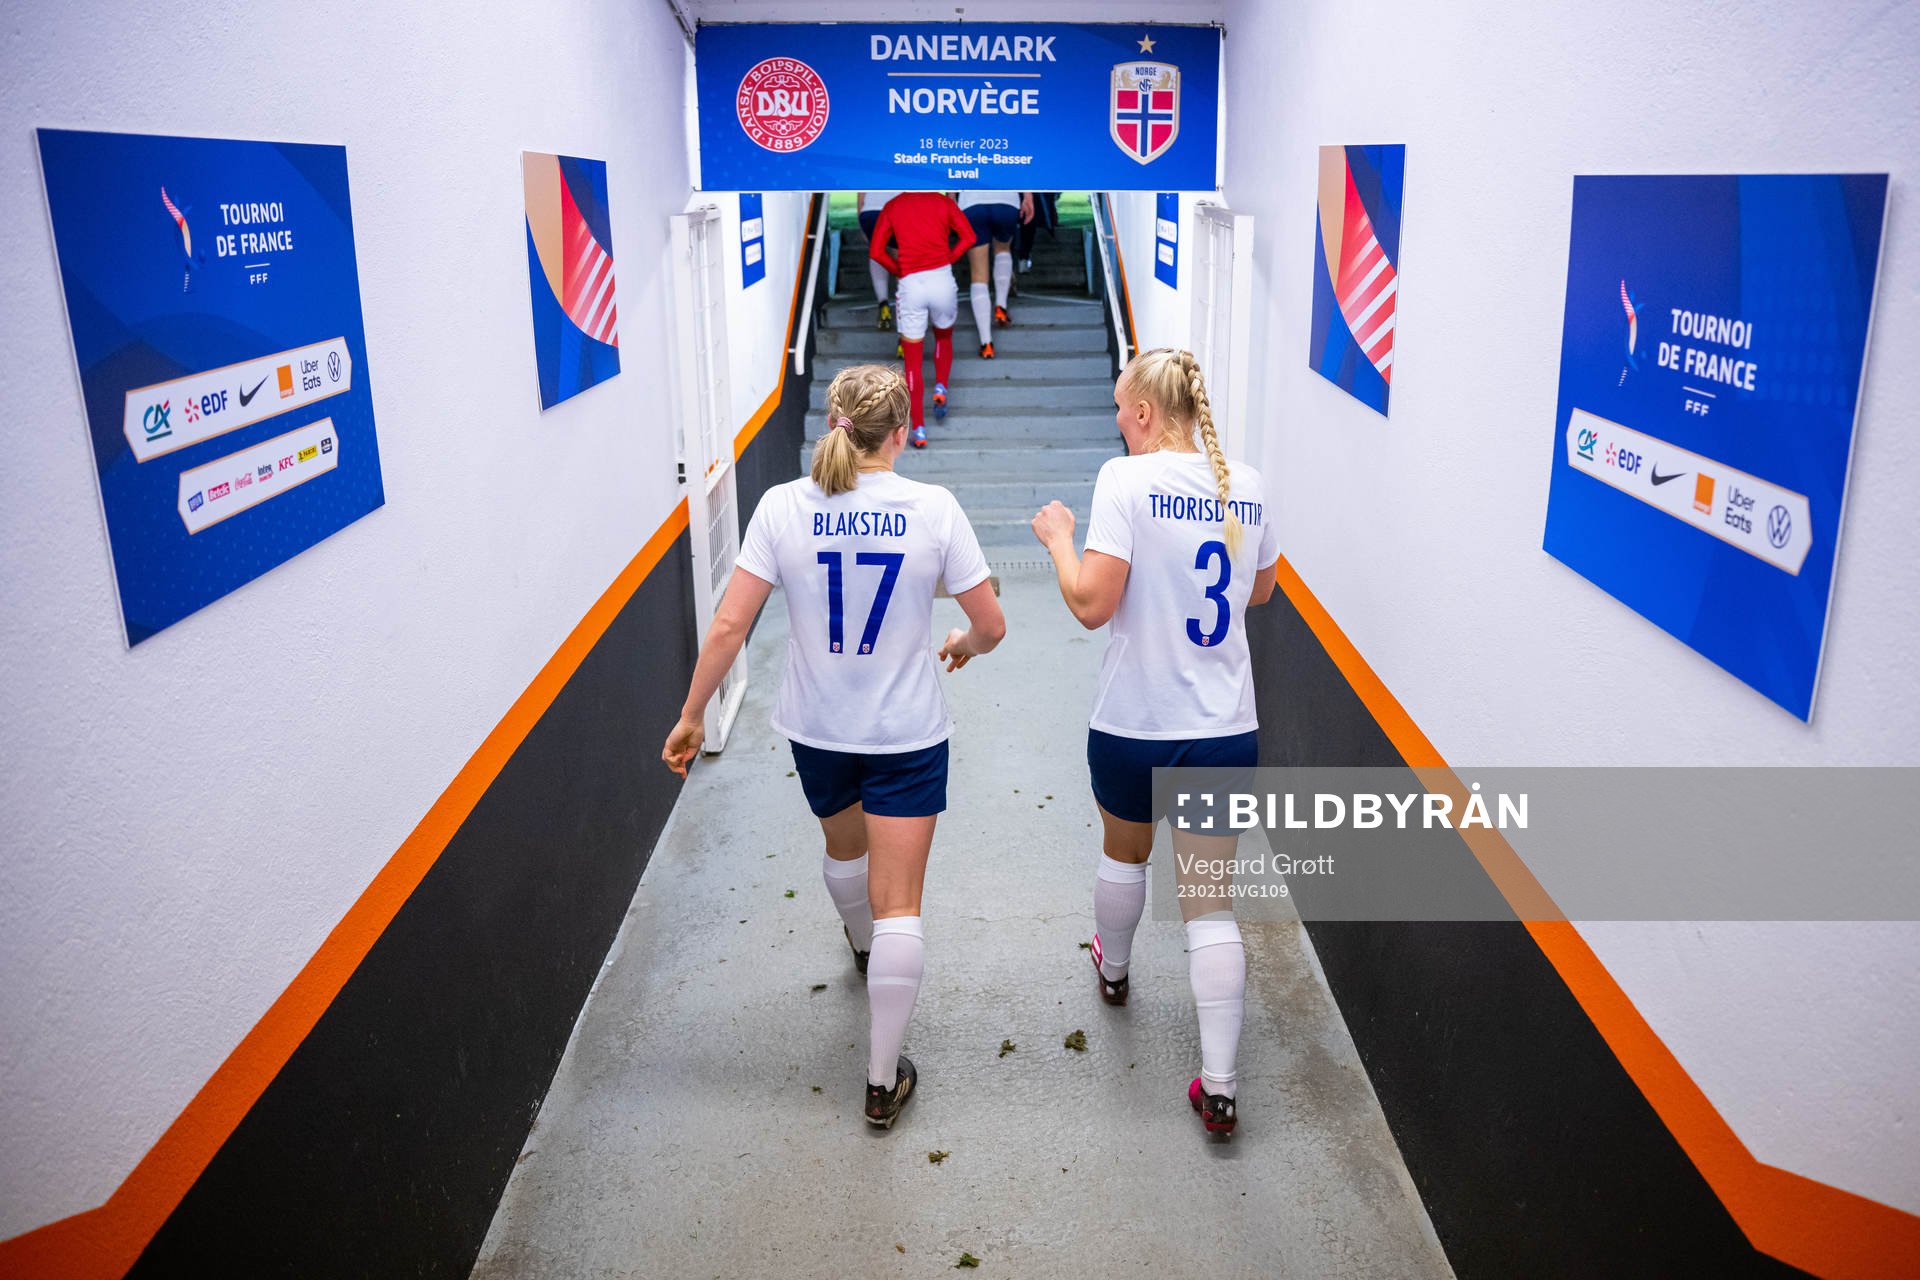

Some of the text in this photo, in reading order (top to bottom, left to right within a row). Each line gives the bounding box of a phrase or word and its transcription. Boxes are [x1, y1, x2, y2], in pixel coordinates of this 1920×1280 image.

[870, 34, 1057, 62] DANEMARK
[1135, 66, 1157, 76] NORGE
[755, 89, 810, 118] DBU
[888, 81, 1040, 115] NORVÈGE
[740, 84, 763, 140] DANSK
[766, 137, 803, 149] 1889
[919, 137, 1009, 150] 18 février 2023
[893, 153, 1033, 165] Stade Francis-le-Basser
[948, 168, 979, 179] Laval
[220, 202, 284, 226] TOURNOI
[216, 230, 293, 258] DE FRANCE
[249, 272, 268, 285] FFF
[1671, 308, 1753, 350] TOURNOI
[300, 359, 319, 375] Uber
[1657, 342, 1758, 392] DE FRANCE
[302, 375, 322, 391] Eats
[1684, 399, 1710, 417] FFF
[278, 455, 294, 472] KFC
[1728, 485, 1756, 512] Uber
[813, 511, 907, 537] BLAKSTAD
[1724, 506, 1752, 535] Eats
[816, 551, 906, 655] 17
[1186, 540, 1231, 648] 3
